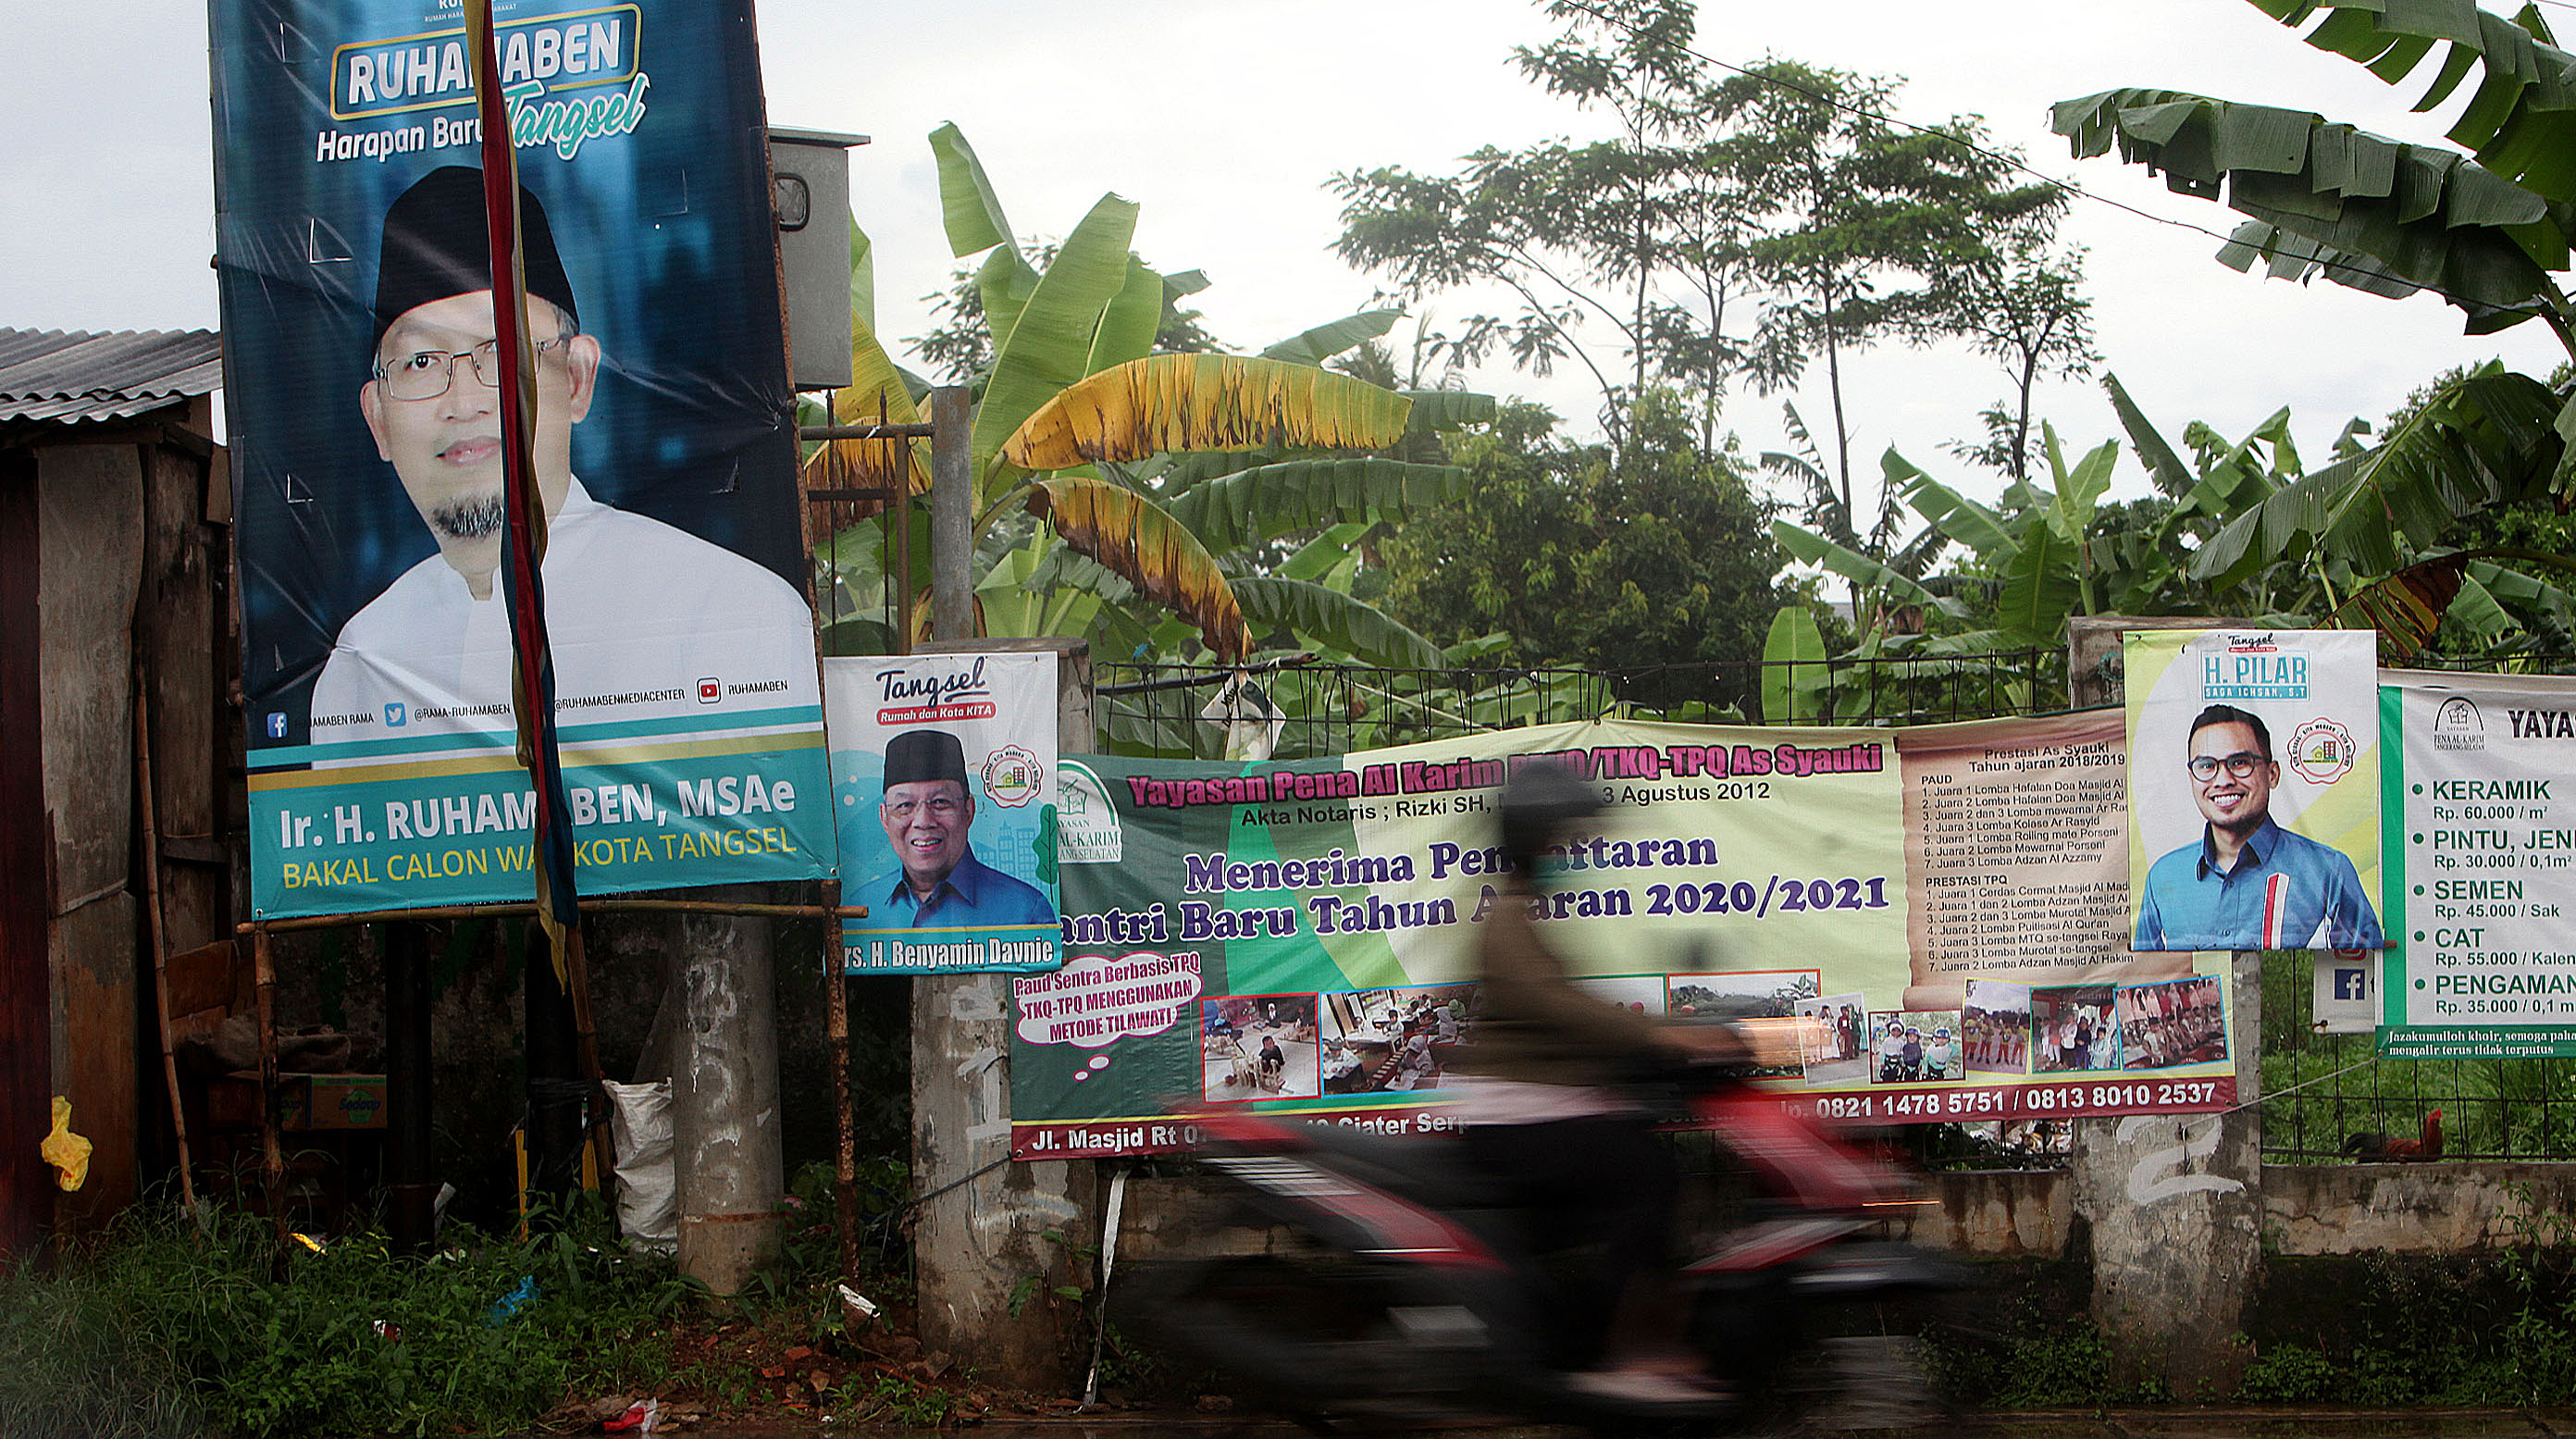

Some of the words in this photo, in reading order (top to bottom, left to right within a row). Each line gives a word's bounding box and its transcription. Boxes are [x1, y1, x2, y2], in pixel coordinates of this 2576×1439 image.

[348, 19, 620, 105] RUHAABEN
[316, 125, 425, 163] Harapan
[505, 76, 649, 158] Tangsel
[2228, 633, 2274, 648] Tangsel
[2206, 657, 2227, 683] H.
[2235, 657, 2306, 683] PILAR
[728, 679, 788, 696] RUHAMABEN
[876, 655, 987, 709] Tangsel
[555, 688, 686, 712] @RUHAMABENMEDIACENTER
[349, 713, 374, 725] RAMA
[881, 709, 917, 723] Rumah
[919, 706, 937, 719] dan
[939, 705, 964, 718] Kota
[967, 704, 993, 717] KITA
[2508, 710, 2576, 738] YAYA
[1985, 749, 2037, 759] Prestasi
[2043, 747, 2060, 757] As
[2065, 742, 2110, 757] Syauki
[1969, 760, 2010, 773] Tahun
[2014, 758, 2055, 773] ajaran
[2060, 754, 2125, 767] 2018/2019
[1127, 775, 1269, 809] Yayasan
[1271, 769, 1360, 802] Pena
[1362, 763, 1400, 796] Al
[1400, 757, 1505, 794] Karim
[1730, 744, 1773, 776] As
[1774, 742, 1884, 777] Syauki
[1922, 775, 1952, 785] PAUD
[1924, 788, 1931, 797] 1.
[1935, 787, 1963, 797] Juara
[1967, 786, 1971, 795] 1
[1975, 784, 2009, 794] Lomba
[2012, 783, 2051, 792] Hafalan
[2054, 781, 2075, 790] Doa
[2079, 779, 2111, 790] Masjid
[2113, 779, 2124, 788] Al
[2433, 780, 2551, 800] KERAMIK
[280, 810, 323, 849] Ir.
[334, 804, 376, 844] H.
[385, 783, 667, 841] RUHAMBEN,
[677, 774, 796, 817] MSAe
[1242, 809, 1291, 826] Akta
[1297, 804, 1377, 825] Notaris
[1395, 797, 1447, 818] Rizki
[1454, 794, 1492, 815] SH,
[1621, 784, 1711, 806] Agustus
[1717, 782, 1770, 800] 2012
[2434, 807, 2458, 822] Rp.
[2465, 806, 2515, 819] 60.000
[2520, 806, 2524, 819] /
[1059, 831, 1119, 847] AL-KARIM
[2434, 830, 2515, 853] PINTU,
[2524, 830, 2576, 850] JEN
[283, 857, 378, 889] BAKAL
[387, 848, 488, 881] CALON
[659, 826, 798, 862] TANGSEL
[1082, 848, 1119, 860] SELATAN
[1926, 860, 1934, 868] 7.
[1938, 859, 1965, 868] Juara
[1969, 858, 1975, 866] 3
[1977, 856, 2012, 866] Lomba
[2015, 855, 2047, 865] Adzan
[2050, 854, 2059, 863] Al
[2062, 853, 2101, 863] Azzamy
[2434, 855, 2459, 871] Rp.
[2466, 855, 2515, 868] 30.000
[2520, 854, 2525, 868] /
[1184, 849, 1416, 893] Menerima
[1926, 876, 1980, 887] PRESTASI
[1984, 875, 2008, 885] TPQ
[2434, 880, 2523, 899] SEMEN
[1059, 903, 1169, 945] antri
[1180, 900, 1297, 941] Baru
[1307, 894, 1458, 934] Tahun
[1470, 883, 1633, 923] Aaran
[1645, 875, 1889, 919] 2020/2021
[2435, 904, 2460, 920] Rp.
[2466, 904, 2516, 917] 45.000
[2521, 904, 2525, 917] /
[2531, 904, 2559, 917] Sak
[2435, 928, 2484, 948] CAT
[844, 946, 867, 968] rs.
[871, 941, 887, 967] H.
[892, 939, 985, 970] Benyamin
[988, 937, 1053, 964] Davnie
[1930, 962, 1938, 972] 7.
[1942, 962, 1970, 972] Juara
[1974, 961, 1979, 970] 2
[1982, 960, 2015, 969] Lomba
[2019, 959, 2050, 967] Adzan
[2054, 957, 2087, 967] Masjid
[2089, 956, 2099, 964] Al
[2102, 954, 2134, 963] Hakim
[2435, 952, 2461, 968] Rp.
[2467, 952, 2517, 966] 55.000
[2522, 952, 2527, 965] /
[1015, 974, 1051, 997] Paud
[1054, 969, 1102, 991] Sentra
[1104, 959, 1170, 984] Berbasis
[1170, 952, 1200, 974] TPQ
[1024, 997, 1083, 1021] TKQ-TPQ
[1085, 979, 1193, 1011] MENGGUNAKAN
[2436, 1000, 2462, 1016] Rp.
[2468, 1000, 2517, 1013] 35.000
[2522, 999, 2527, 1013] /
[2533, 999, 2554, 1014] 0,1
[1049, 1019, 1103, 1042] METODE
[1105, 1008, 1171, 1032] TILAWATI
[2389, 1031, 2465, 1044] Jazakumulloh
[2468, 1031, 2502, 1043] khoir,
[2505, 1032, 2546, 1043] semoga
[2390, 1045, 2439, 1057] mengalir
[2443, 1046, 2471, 1055] terus
[2474, 1044, 2502, 1055] tidak
[2506, 1046, 2554, 1057] terputus
[1033, 1130, 1060, 1151] Jl.
[1069, 1127, 1144, 1153] Masjid
[1151, 1125, 1177, 1146] Rt
[1816, 1096, 1872, 1119] 0821
[1883, 1094, 1939, 1116] 1478
[1948, 1091, 2004, 1113] 5751
[2012, 1090, 2021, 1111] /
[2026, 1087, 2085, 1110] 0813
[2092, 1085, 2150, 1108] 8010
[2158, 1083, 2216, 1105] 2537
